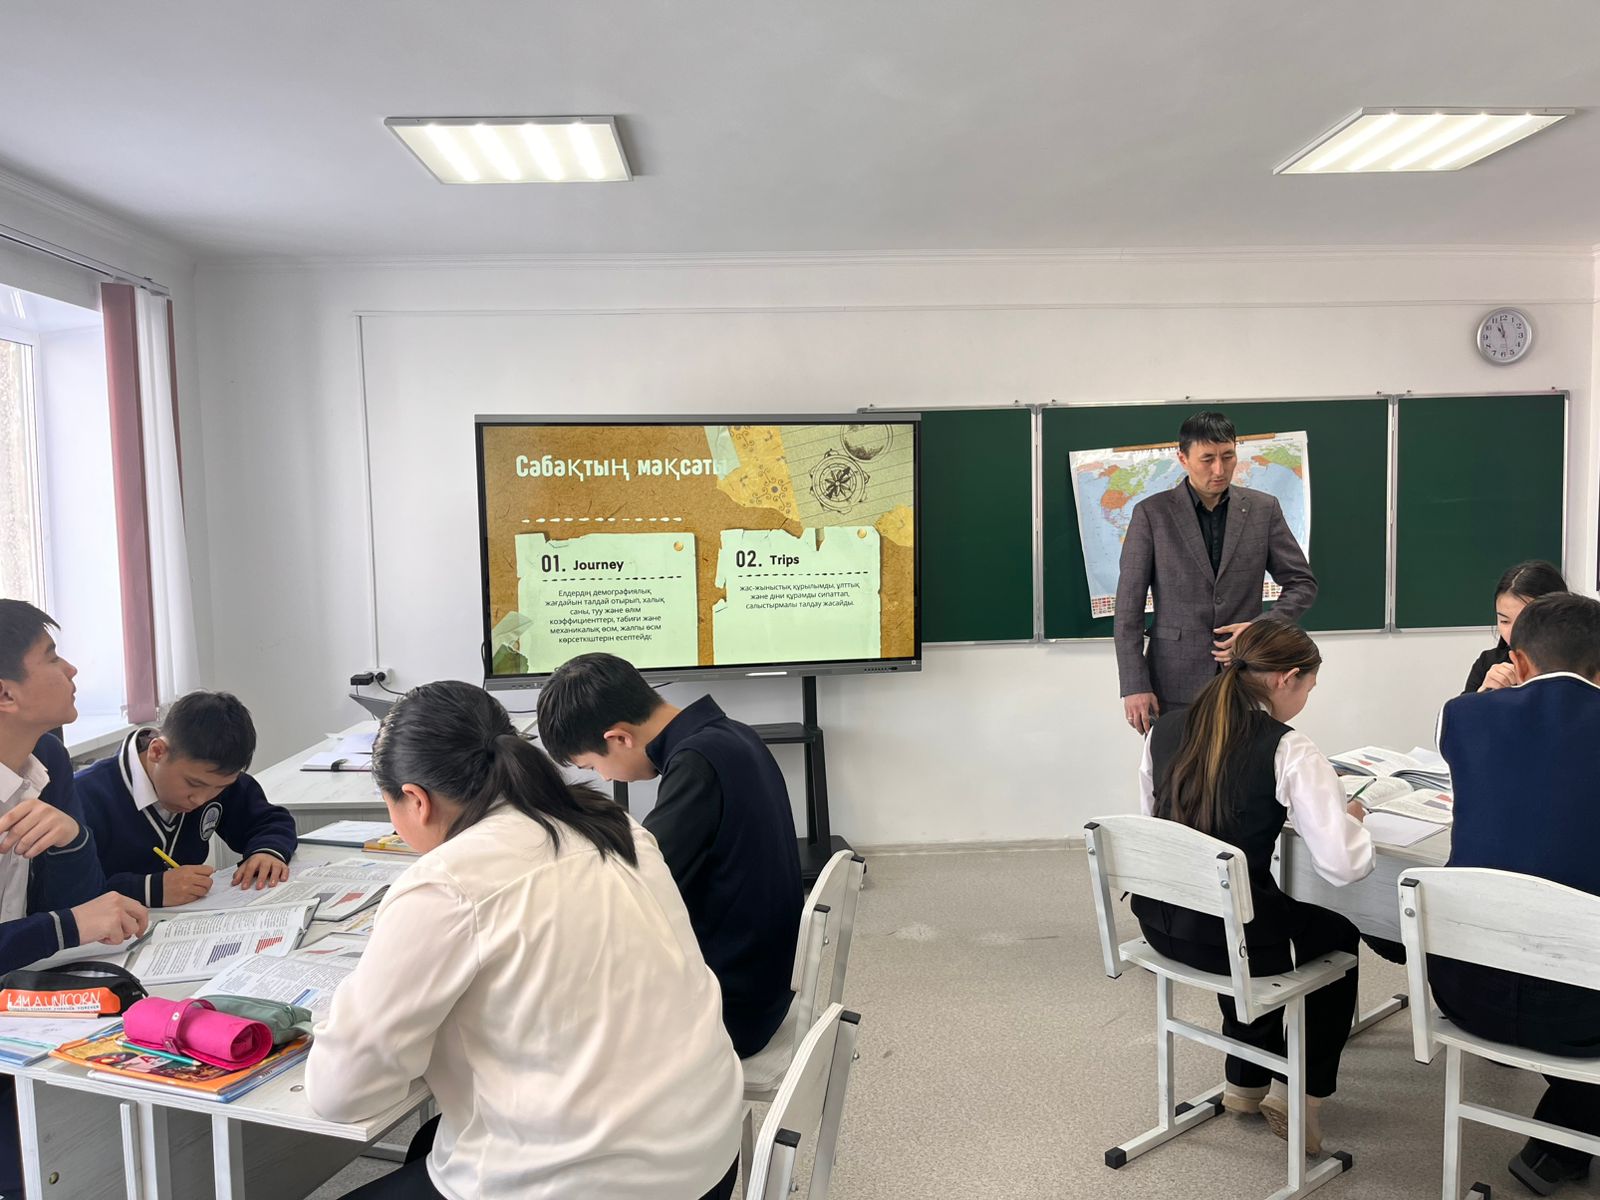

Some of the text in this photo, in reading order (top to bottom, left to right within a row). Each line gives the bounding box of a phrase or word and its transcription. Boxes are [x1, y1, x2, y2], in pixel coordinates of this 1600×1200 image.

[516, 455, 728, 482] Сабақтың мақсаты
[542, 554, 624, 572] 01. Journey
[736, 550, 800, 568] 02. Trips
[558, 588, 652, 598] Елдердің демографиялық
[584, 598, 610, 606] талдай
[746, 601, 798, 610] салыстырмалы
[550, 626, 600, 634] механикалық
[14, 993, 30, 1007] AM
[32, 995, 41, 1007] A
[44, 991, 100, 1007] UNICORN
